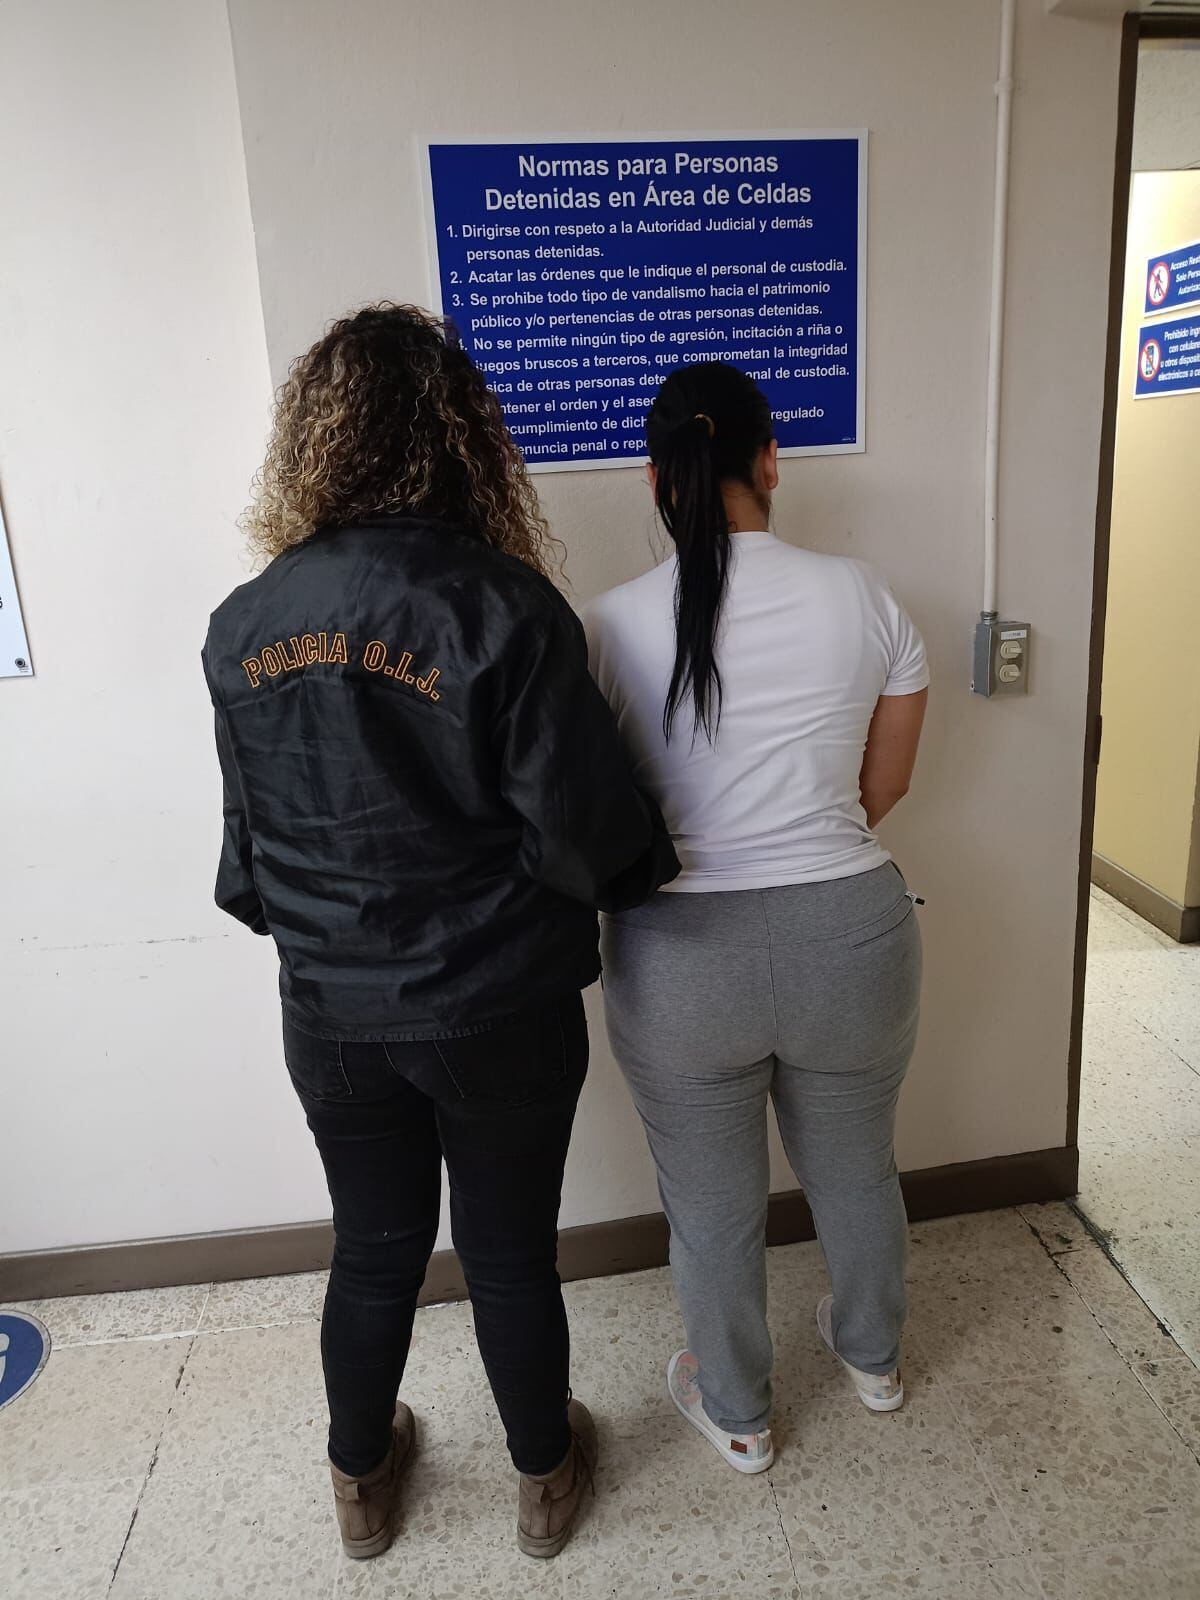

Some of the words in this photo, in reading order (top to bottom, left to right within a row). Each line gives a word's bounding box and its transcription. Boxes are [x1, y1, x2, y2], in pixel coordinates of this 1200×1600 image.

[519, 156, 608, 176] Normas
[618, 159, 666, 180] para
[676, 153, 778, 173] Personas
[486, 188, 600, 210] Detenidas
[609, 192, 635, 207] en
[644, 181, 695, 206] Área
[703, 184, 729, 205] de
[738, 183, 811, 204] Celdas
[447, 225, 457, 237] 1.
[463, 224, 520, 240] Dirigirse
[525, 226, 549, 235] con
[555, 223, 605, 237] respeto
[610, 224, 616, 233] a
[622, 221, 632, 233] la
[637, 219, 701, 232] Autoridad
[706, 218, 755, 230] Judicial
[760, 221, 766, 232] y
[771, 216, 813, 228] demás
[467, 250, 530, 263] personas
[535, 245, 603, 258] detenidas.
[451, 271, 462, 283] 2.
[469, 271, 513, 283] Acatar
[518, 270, 536, 281] las
[541, 268, 595, 280] órdenes
[600, 269, 624, 281] que
[629, 266, 639, 277] le
[644, 265, 691, 279] indique
[696, 264, 706, 275] el
[712, 262, 766, 277] personal
[771, 261, 786, 272] de
[791, 259, 846, 272] custodia.
[453, 294, 463, 306] 3.
[471, 293, 487, 305] Se
[493, 292, 543, 308] prohibe
[548, 290, 577, 303] todo
[582, 289, 607, 304] tipo
[612, 289, 627, 300] de
[632, 287, 705, 299] vandalismo
[711, 284, 743, 296] hacia
[748, 284, 758, 295] el
[763, 281, 830, 297] patrimonio
[472, 315, 521, 331] público
[525, 314, 544, 329] y/o
[550, 311, 634, 328] pertenencias
[639, 310, 654, 321] de
[659, 309, 691, 320] otras
[696, 308, 754, 322] personas
[759, 303, 822, 316] detenidas.
[474, 338, 492, 349] No
[497, 340, 512, 349] se
[517, 335, 566, 351] permite
[572, 333, 616, 348] ningún
[621, 332, 645, 346] tipo
[650, 331, 665, 342] de
[670, 328, 727, 344] agresión,
[733, 325, 792, 338] incitación
[797, 327, 803, 336] a
[808, 324, 830, 335] riña
[835, 326, 842, 334] o
[525, 358, 578, 369] bruscos
[583, 359, 590, 367] a
[594, 356, 650, 366] terceros,
[655, 354, 678, 366] que
[683, 347, 769, 362] comprometan
[774, 347, 784, 358] la
[789, 344, 847, 359] integridad
[487, 381, 512, 393] sica
[517, 380, 532, 391] de
[538, 379, 570, 390] otras
[576, 378, 635, 391] personas
[775, 367, 790, 378] de
[794, 365, 849, 377] custodia.
[545, 400, 555, 411] el
[560, 399, 597, 410] orden
[602, 400, 608, 411] y
[613, 396, 624, 408] el
[505, 420, 598, 436] cumplimiento
[602, 418, 617, 429] de
[771, 407, 824, 422] regulado
[518, 440, 568, 456] enuncia
[573, 439, 606, 454] penal
[611, 441, 619, 449] o
[242, 632, 348, 688] POLICIA
[363, 640, 441, 701] O.I.J.
